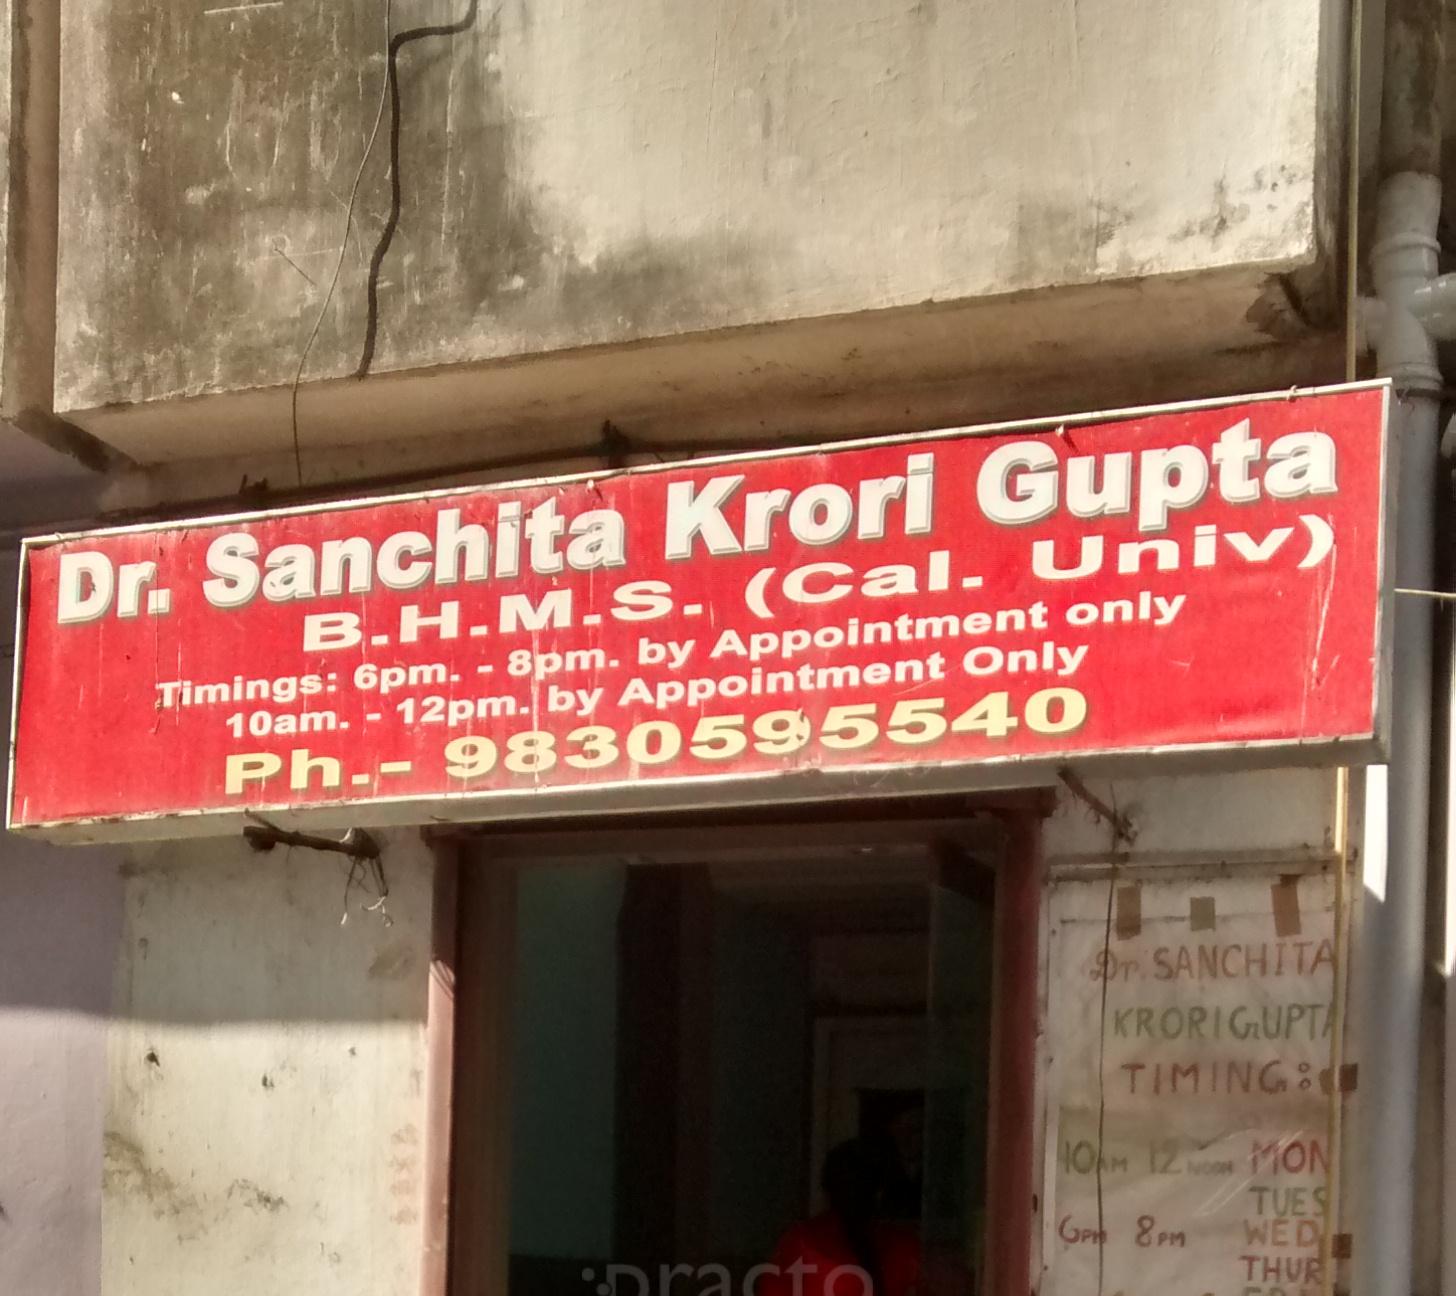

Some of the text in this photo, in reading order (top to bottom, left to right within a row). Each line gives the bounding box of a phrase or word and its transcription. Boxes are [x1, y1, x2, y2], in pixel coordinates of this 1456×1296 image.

[57, 418, 1338, 625] Dr. Sanchita Krori Gupta
[302, 515, 1336, 652] B.H.M.S. (Cal. Univ)
[157, 671, 337, 710] Timings:
[353, 661, 461, 695] 6pm.
[507, 643, 620, 681] 8pm.
[637, 638, 697, 671] by
[710, 604, 1048, 663] Appointment
[1065, 591, 1187, 626] only
[226, 706, 349, 739] 10am.
[396, 690, 530, 727] 12pm.
[546, 685, 602, 715] by
[617, 655, 946, 709] Appointment
[963, 642, 1089, 681] Only
[443, 687, 1088, 781] 9830595540
[1153, 938, 1334, 982] SANCHITA
[1249, 1139, 1330, 1175] MON
[1243, 1218, 1320, 1248] WED
[1249, 1185, 1330, 1217] TUES
[1238, 1255, 1323, 1285] THUR
